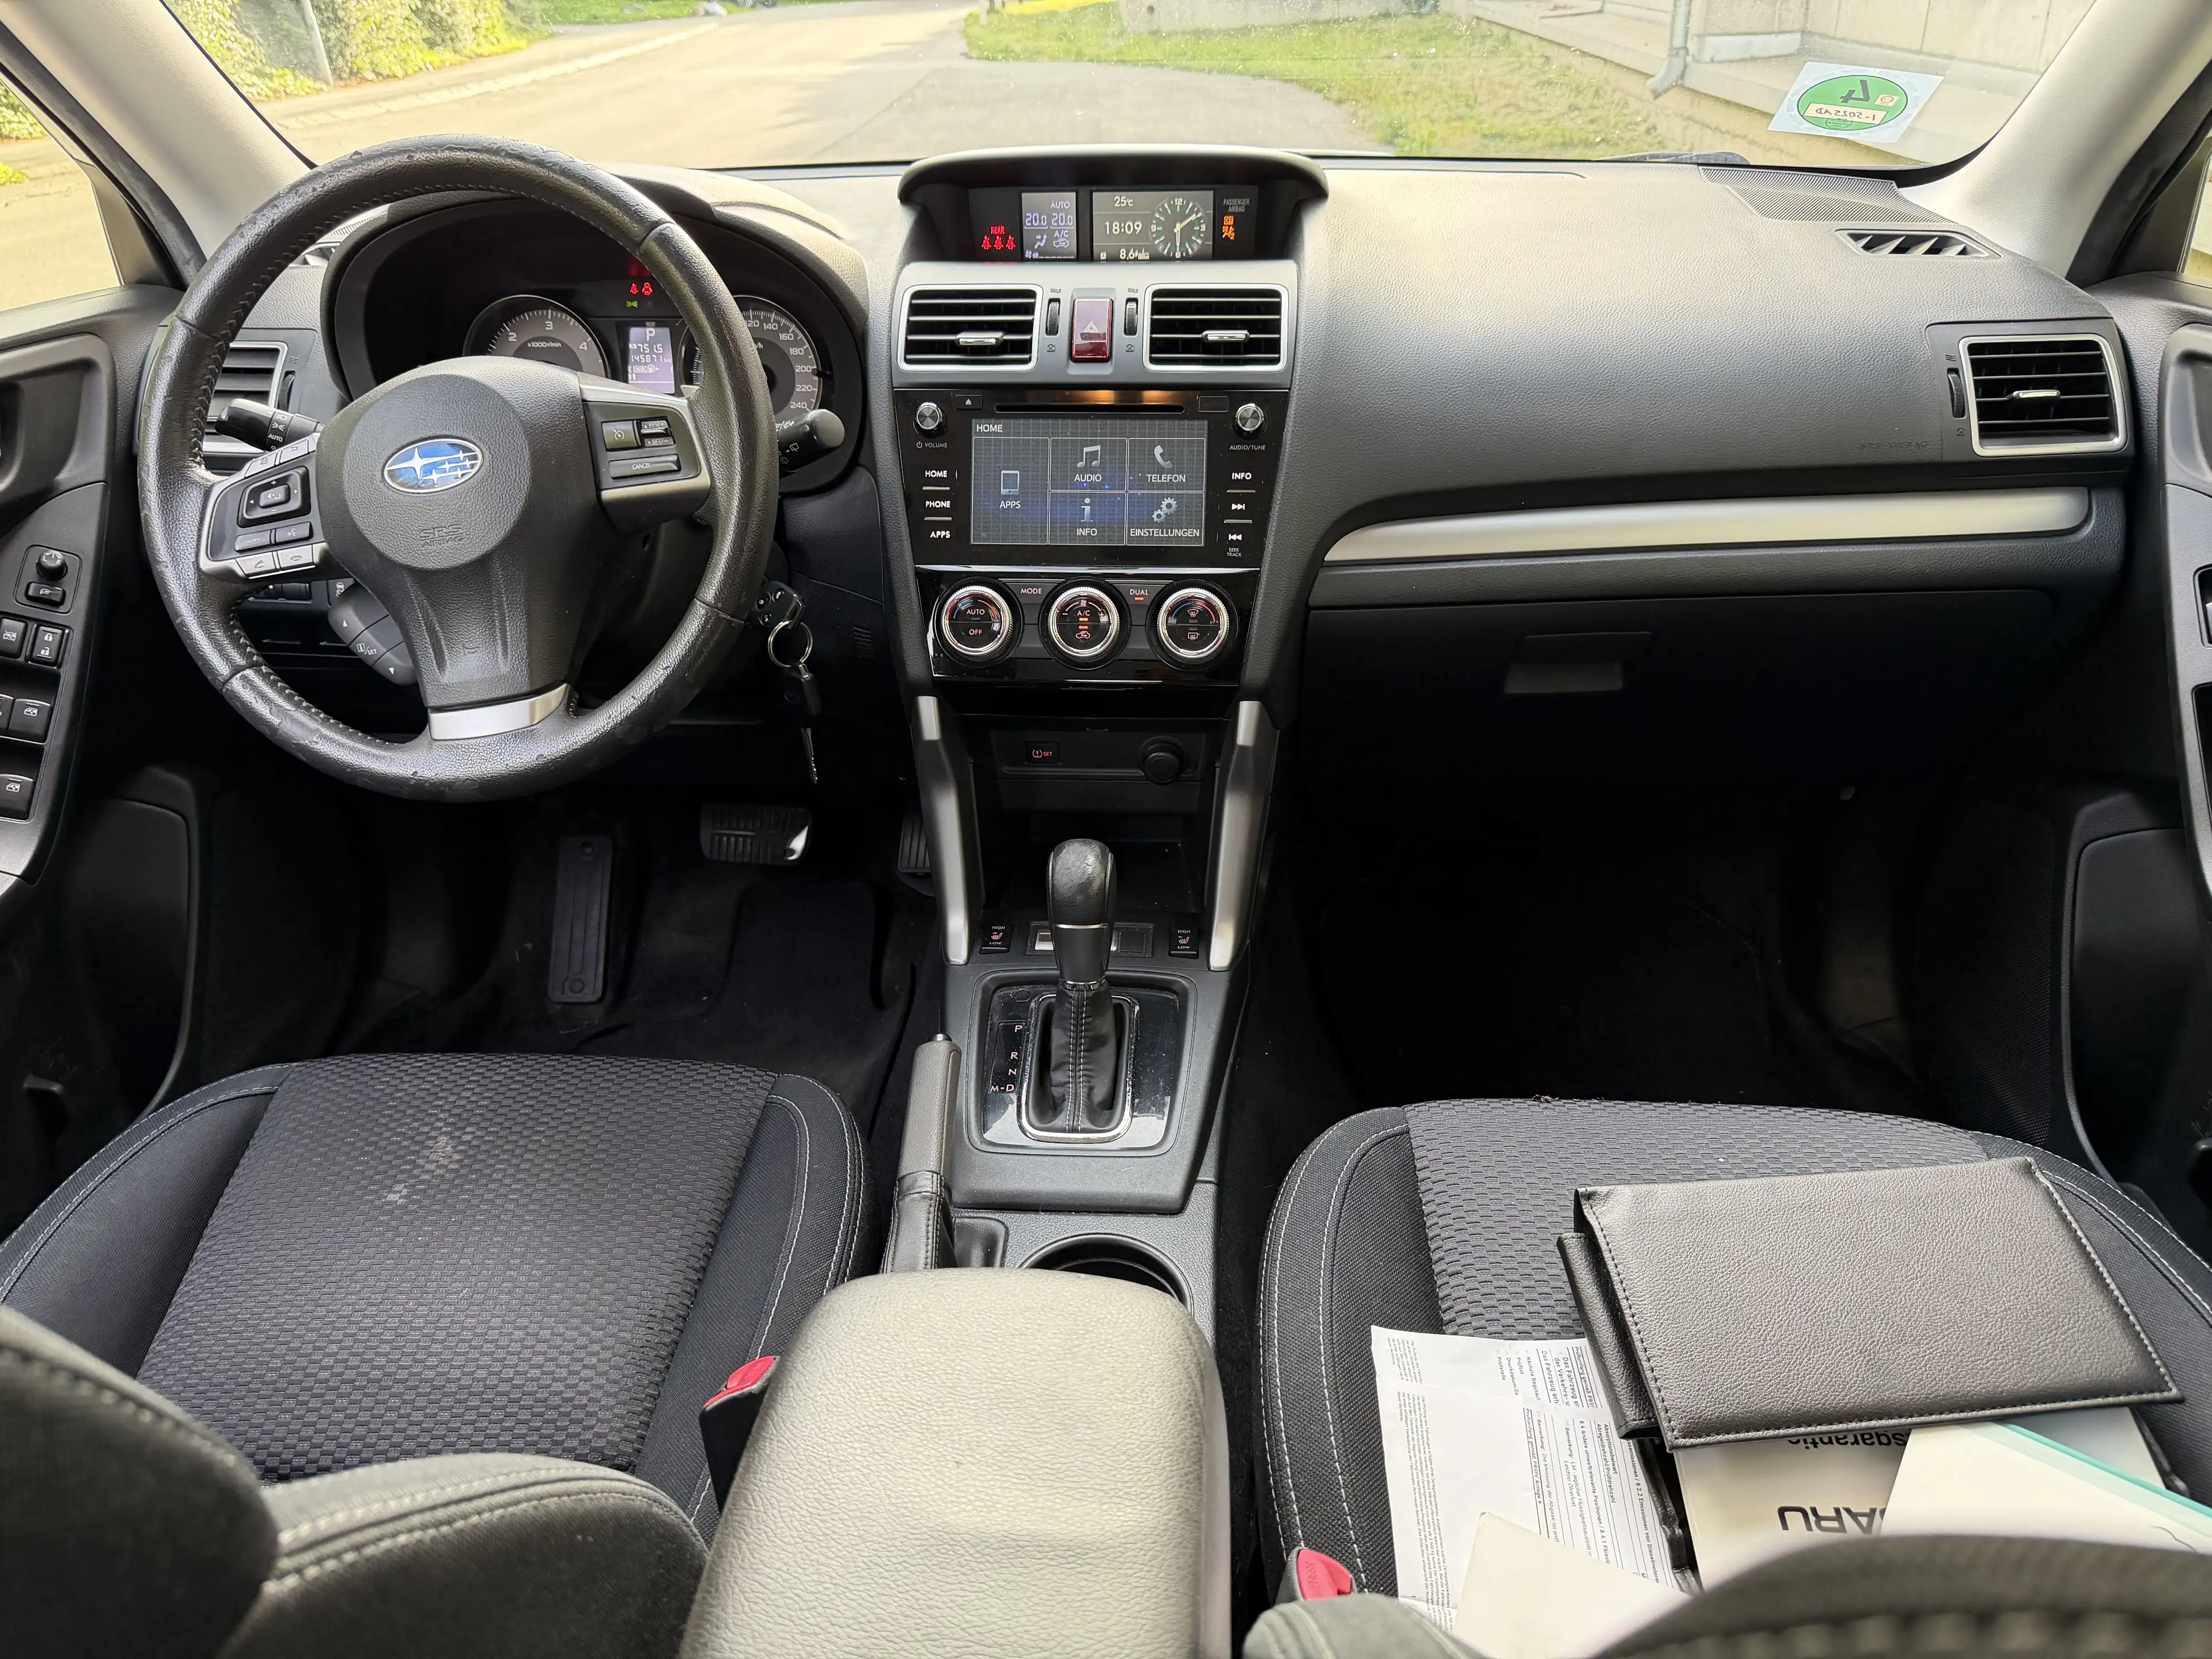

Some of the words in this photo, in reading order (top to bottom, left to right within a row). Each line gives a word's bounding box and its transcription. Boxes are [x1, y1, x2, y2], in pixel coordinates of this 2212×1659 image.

[1050, 201, 1070, 209] AUTO
[1025, 213, 1047, 226] 20.0
[1051, 213, 1073, 226] 20.0
[1224, 217, 1233, 225] OFF
[990, 226, 1005, 234] REAR
[1054, 229, 1069, 237] A/C
[1105, 221, 1142, 235] 18:09
[545, 321, 554, 330] 3
[763, 323, 778, 331] 140
[508, 332, 517, 342] 2
[646, 327, 656, 342] P
[779, 333, 794, 341] 160
[579, 342, 588, 351] 4
[631, 355, 662, 363] 145871
[976, 424, 1003, 433] HOME
[268, 433, 283, 442] AUTO
[1074, 474, 1102, 482] AUDIO
[1146, 474, 1186, 483] TELEFON
[1232, 472, 1252, 480] INFO
[999, 501, 1021, 509] APPS
[930, 531, 950, 539] APPS
[1077, 528, 1097, 536] INFO
[1130, 528, 1200, 537] EINSTELLUNGEN
[1010, 1052, 1018, 1060] R
[1540, 1350, 1549, 1362] Das
[1554, 1357, 1562, 1368] der
[1562, 1356, 1571, 1369] Das
[1543, 1362, 1556, 1392] Fahrzeug
[1565, 1369, 1578, 1400] Fahrzeug
[1551, 1392, 1560, 1406] erh
[1586, 1395, 1595, 1409] PBSt
[1580, 1429, 1589, 1449] Andere
[1603, 1423, 1618, 1475] Absorptionsbeiwert
[1584, 1449, 1597, 1494] umweltrelevante
[1635, 1482, 1643, 1497] 8.2.2
[1547, 1499, 1556, 1521] Abgase
[1592, 1494, 1603, 1525] Positionen
[1638, 1497, 1649, 1531] Emissionen
[1777, 1505, 1887, 1535] ARU
[1599, 1528, 1607, 1543] 8.4.1
